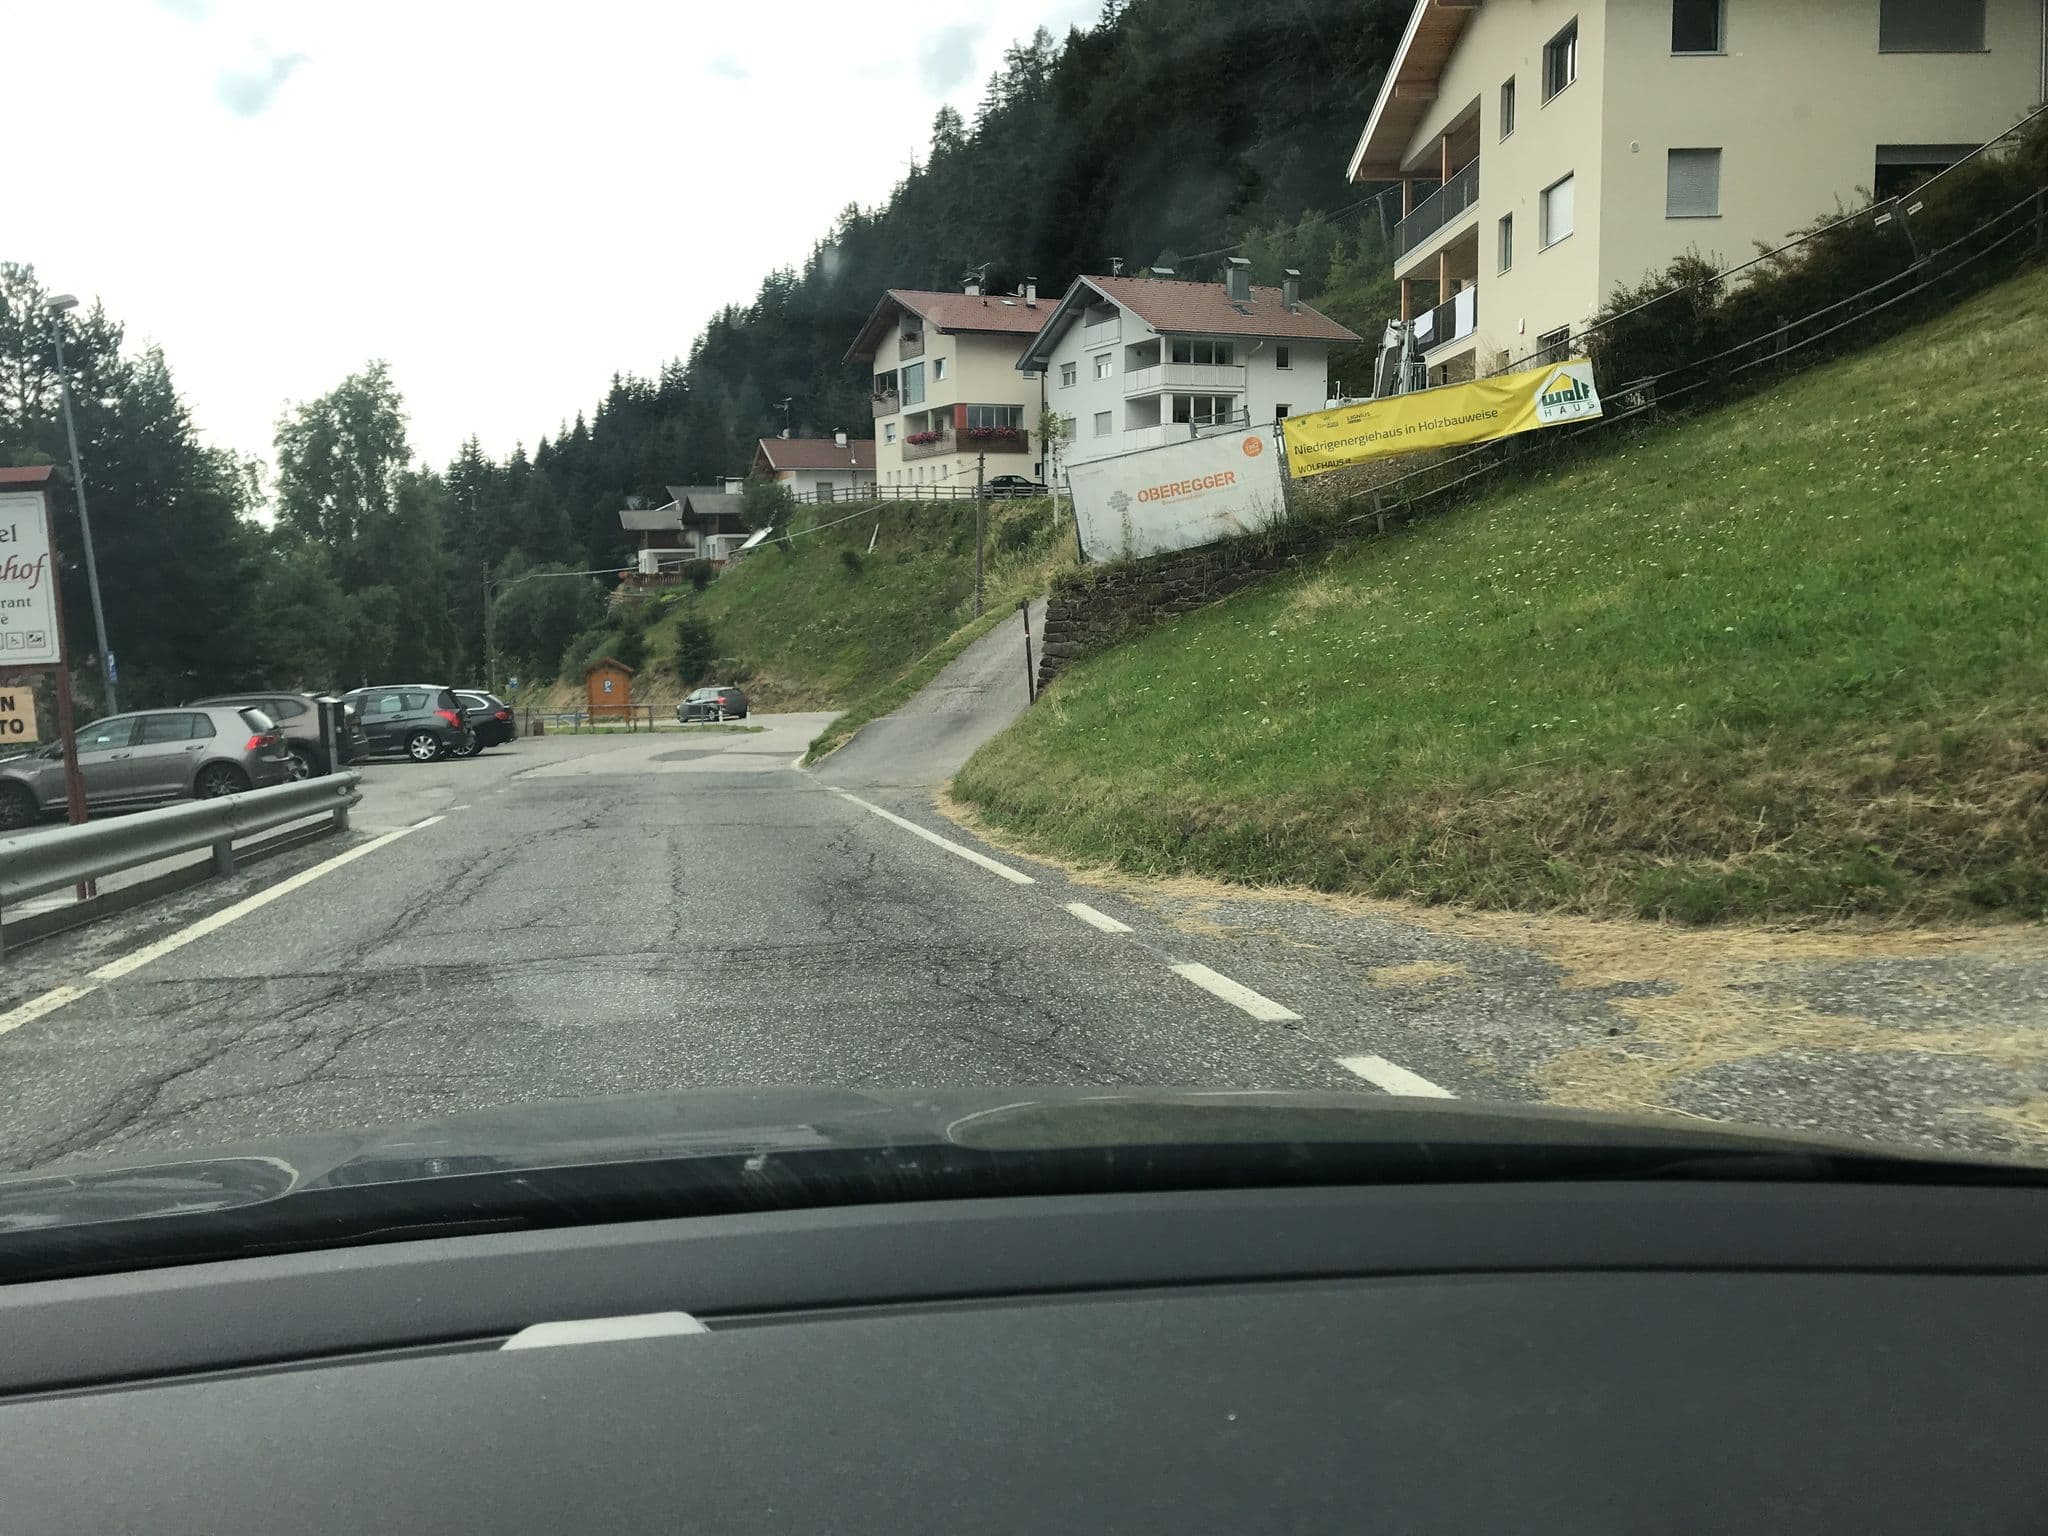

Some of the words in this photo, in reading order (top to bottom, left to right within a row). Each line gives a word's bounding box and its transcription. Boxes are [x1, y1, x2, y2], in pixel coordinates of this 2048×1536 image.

[1544, 400, 1596, 417] HAUS
[1294, 427, 1403, 455] Niedrigenergiehaus
[1405, 423, 1417, 435] in
[1418, 409, 1498, 433] Holzbauweise
[1137, 471, 1236, 503] OBEREGGER
[0, 552, 49, 590] hof
